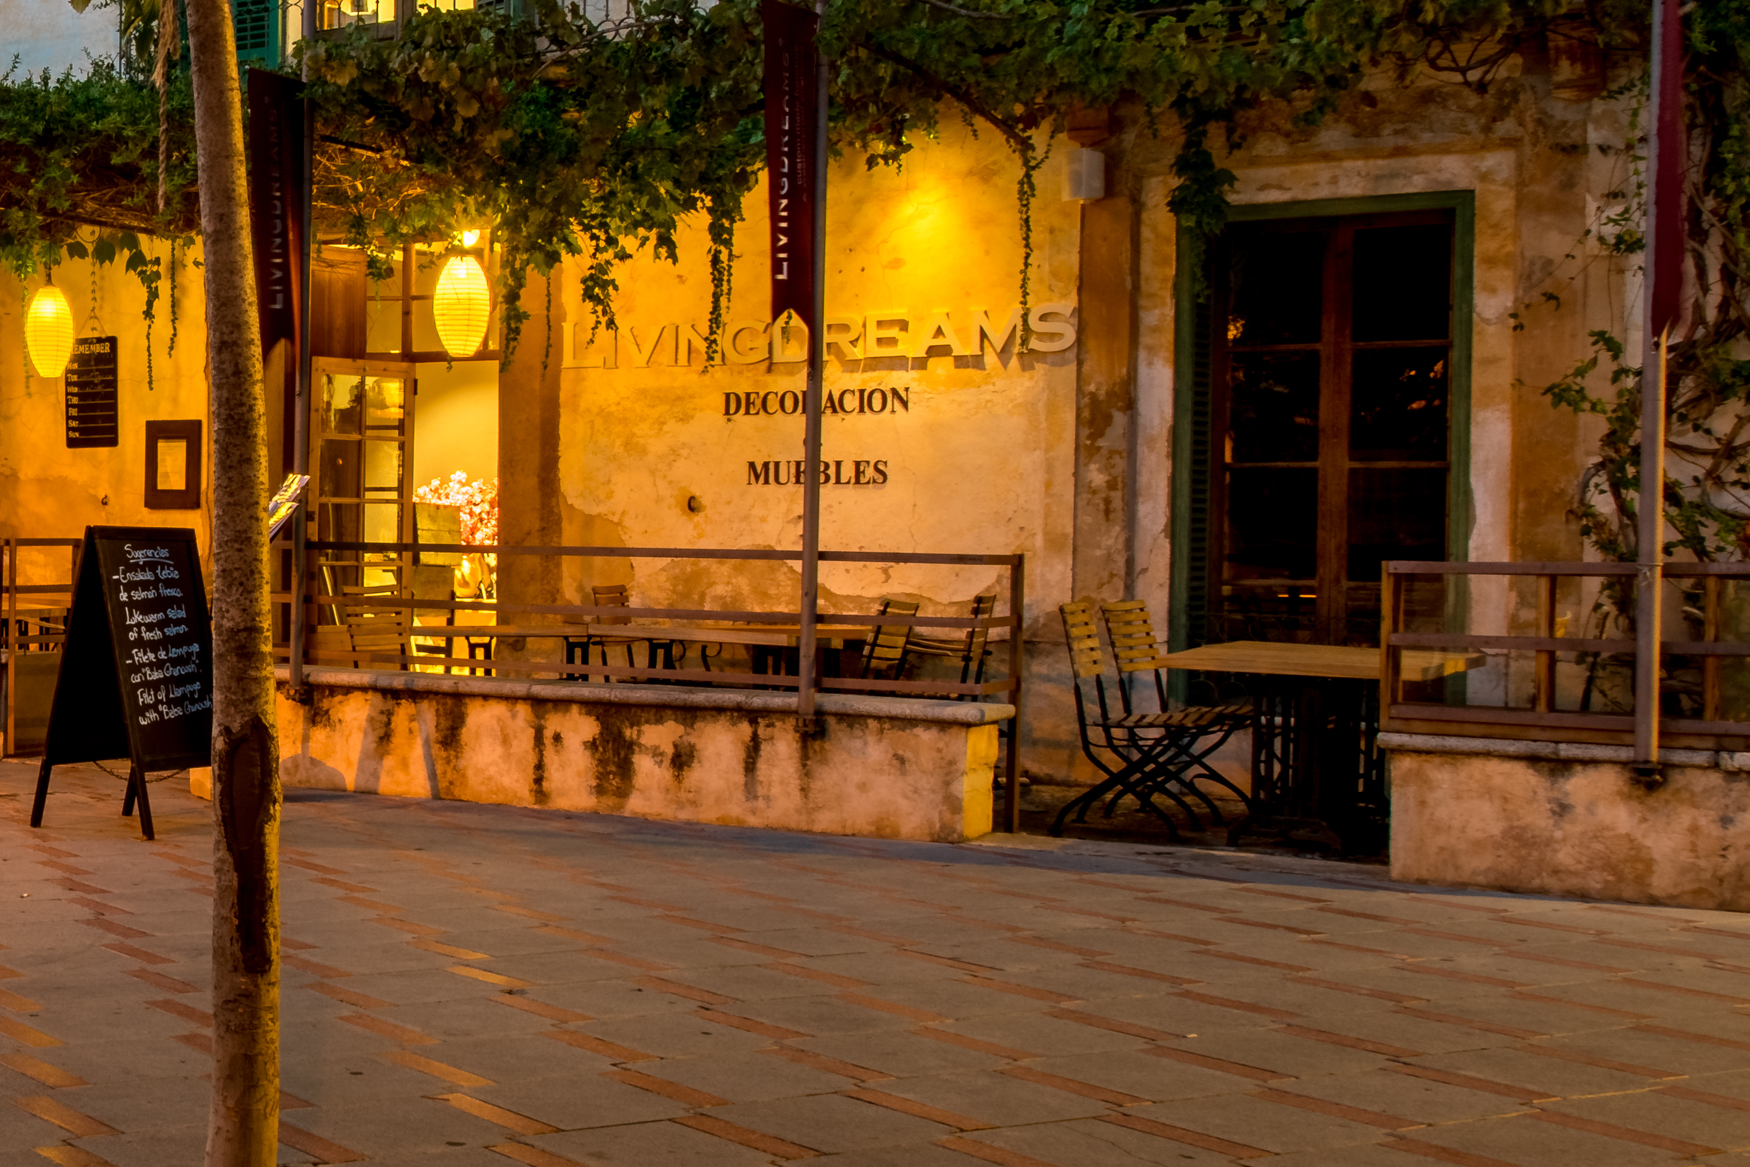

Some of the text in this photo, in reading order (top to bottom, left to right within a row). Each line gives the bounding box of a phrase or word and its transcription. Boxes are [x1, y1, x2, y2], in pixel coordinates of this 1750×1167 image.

[774, 51, 790, 281] LIVINGDREAMS
[73, 342, 110, 354] EMEMBER
[119, 585, 129, 601] de
[166, 603, 187, 619] salad
[128, 627, 138, 641] of
[140, 626, 163, 641] fresh
[157, 645, 168, 659] de
[130, 672, 144, 684] con
[137, 688, 155, 706] Filet
[157, 684, 166, 702] of
[138, 708, 160, 725] with
